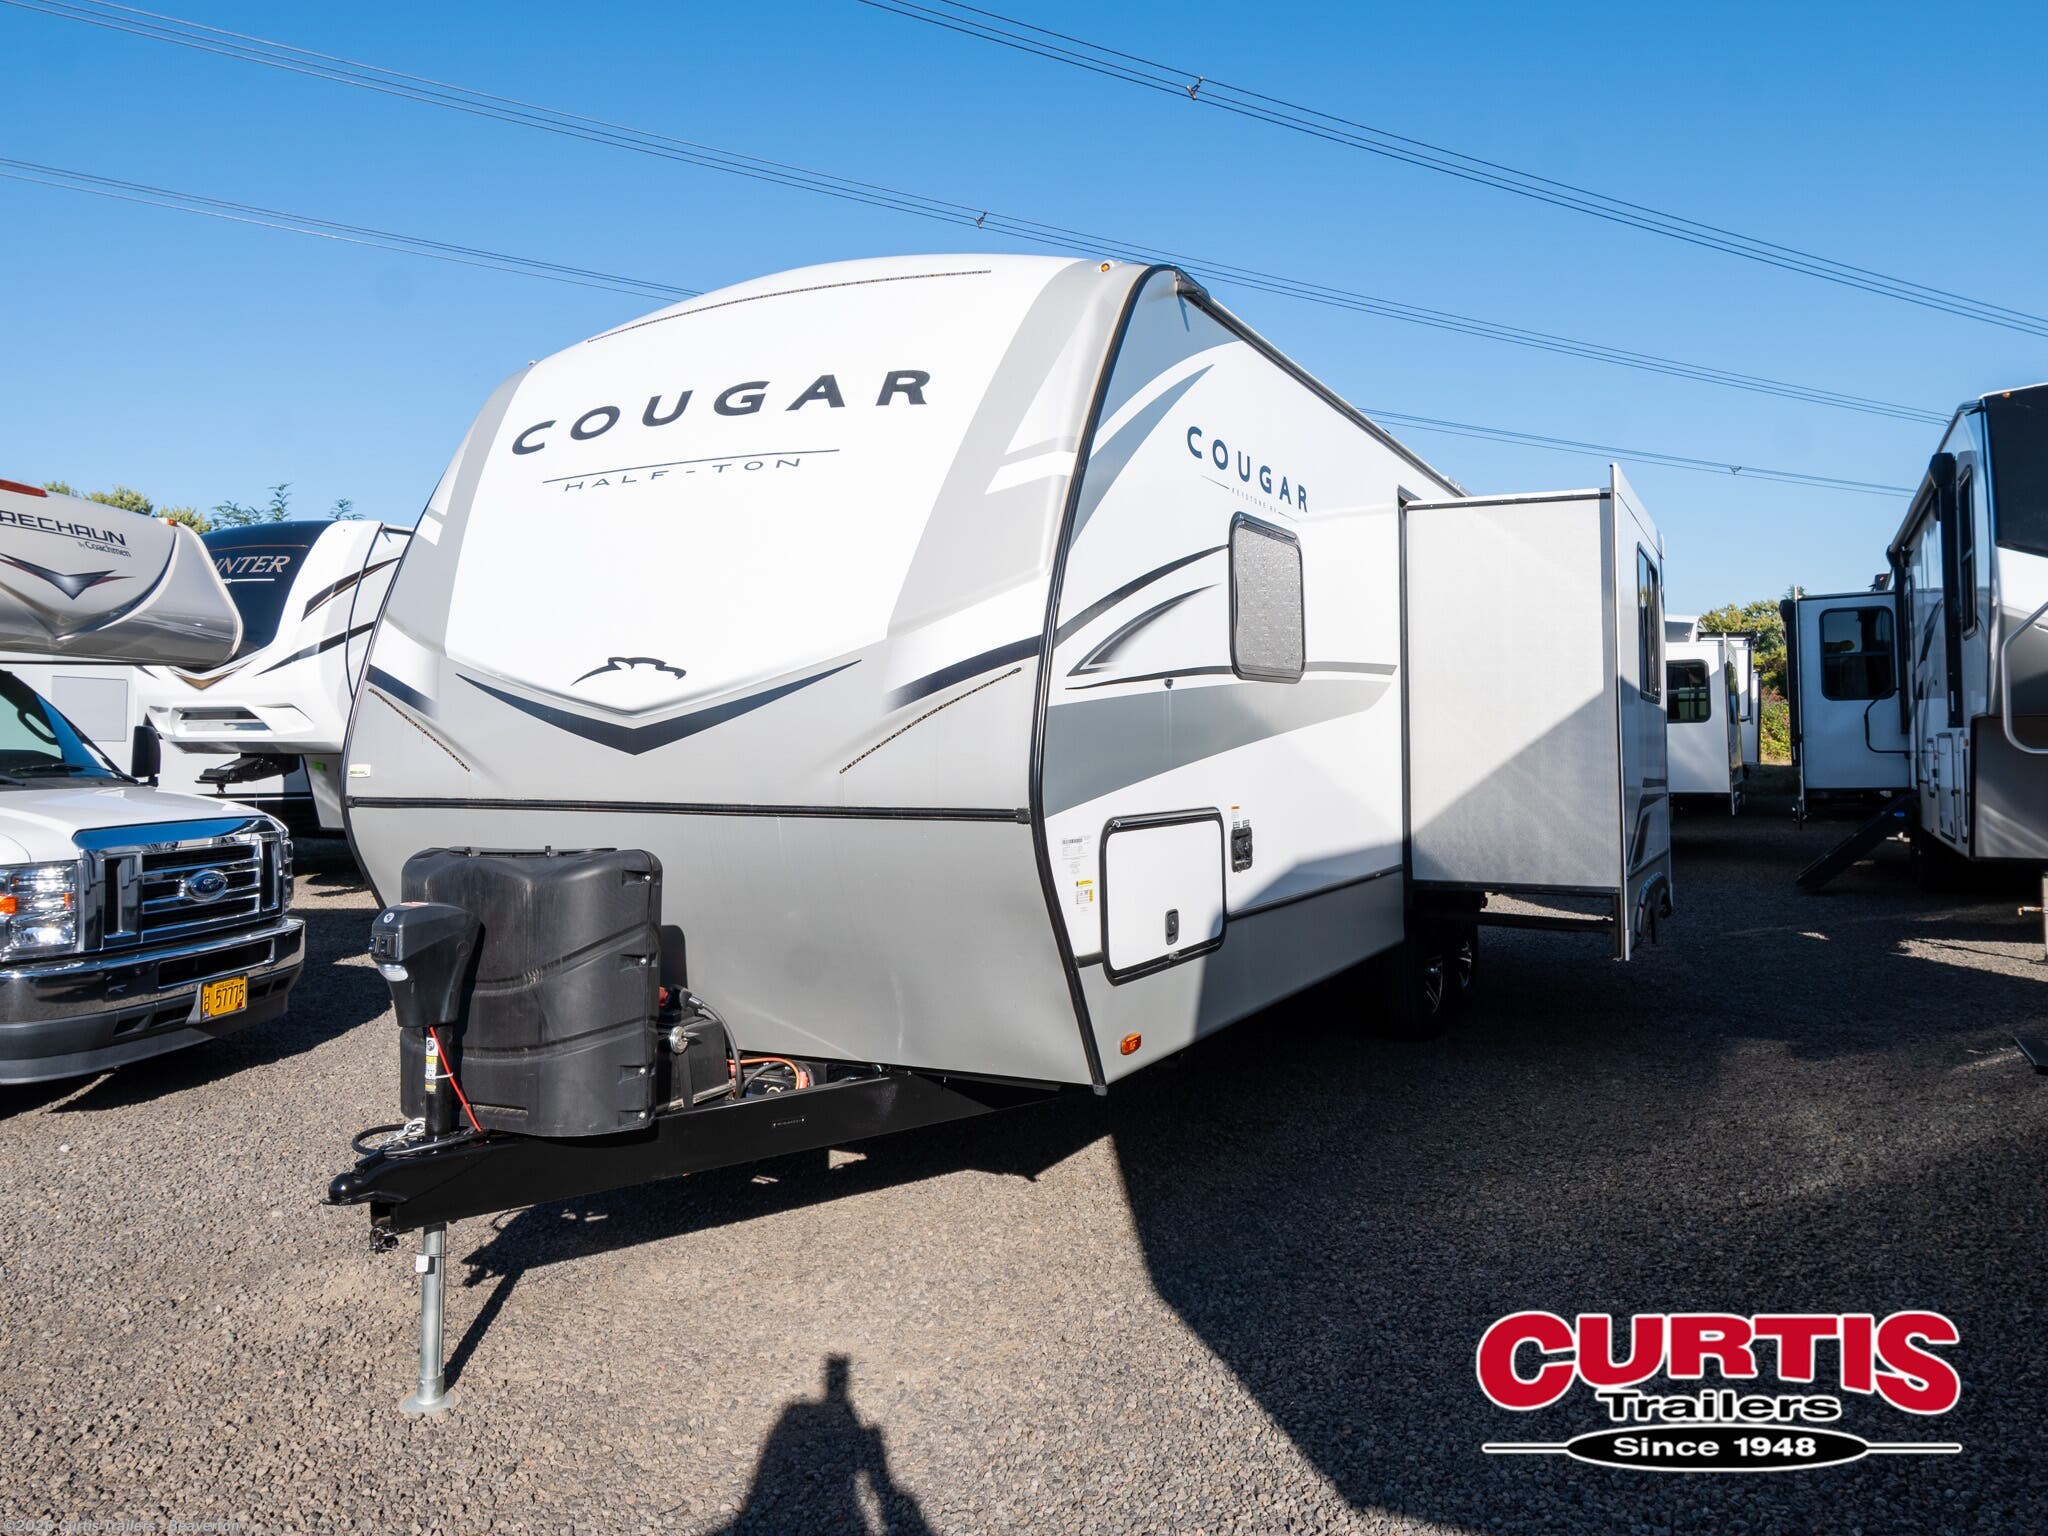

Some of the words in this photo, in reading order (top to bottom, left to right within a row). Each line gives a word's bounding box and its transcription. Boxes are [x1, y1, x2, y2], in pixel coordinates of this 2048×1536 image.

[512, 369, 931, 455] COUGAR
[564, 458, 801, 492] HALF-TON
[1187, 426, 1308, 513] COUGAR
[215, 983, 245, 1008] 57775
